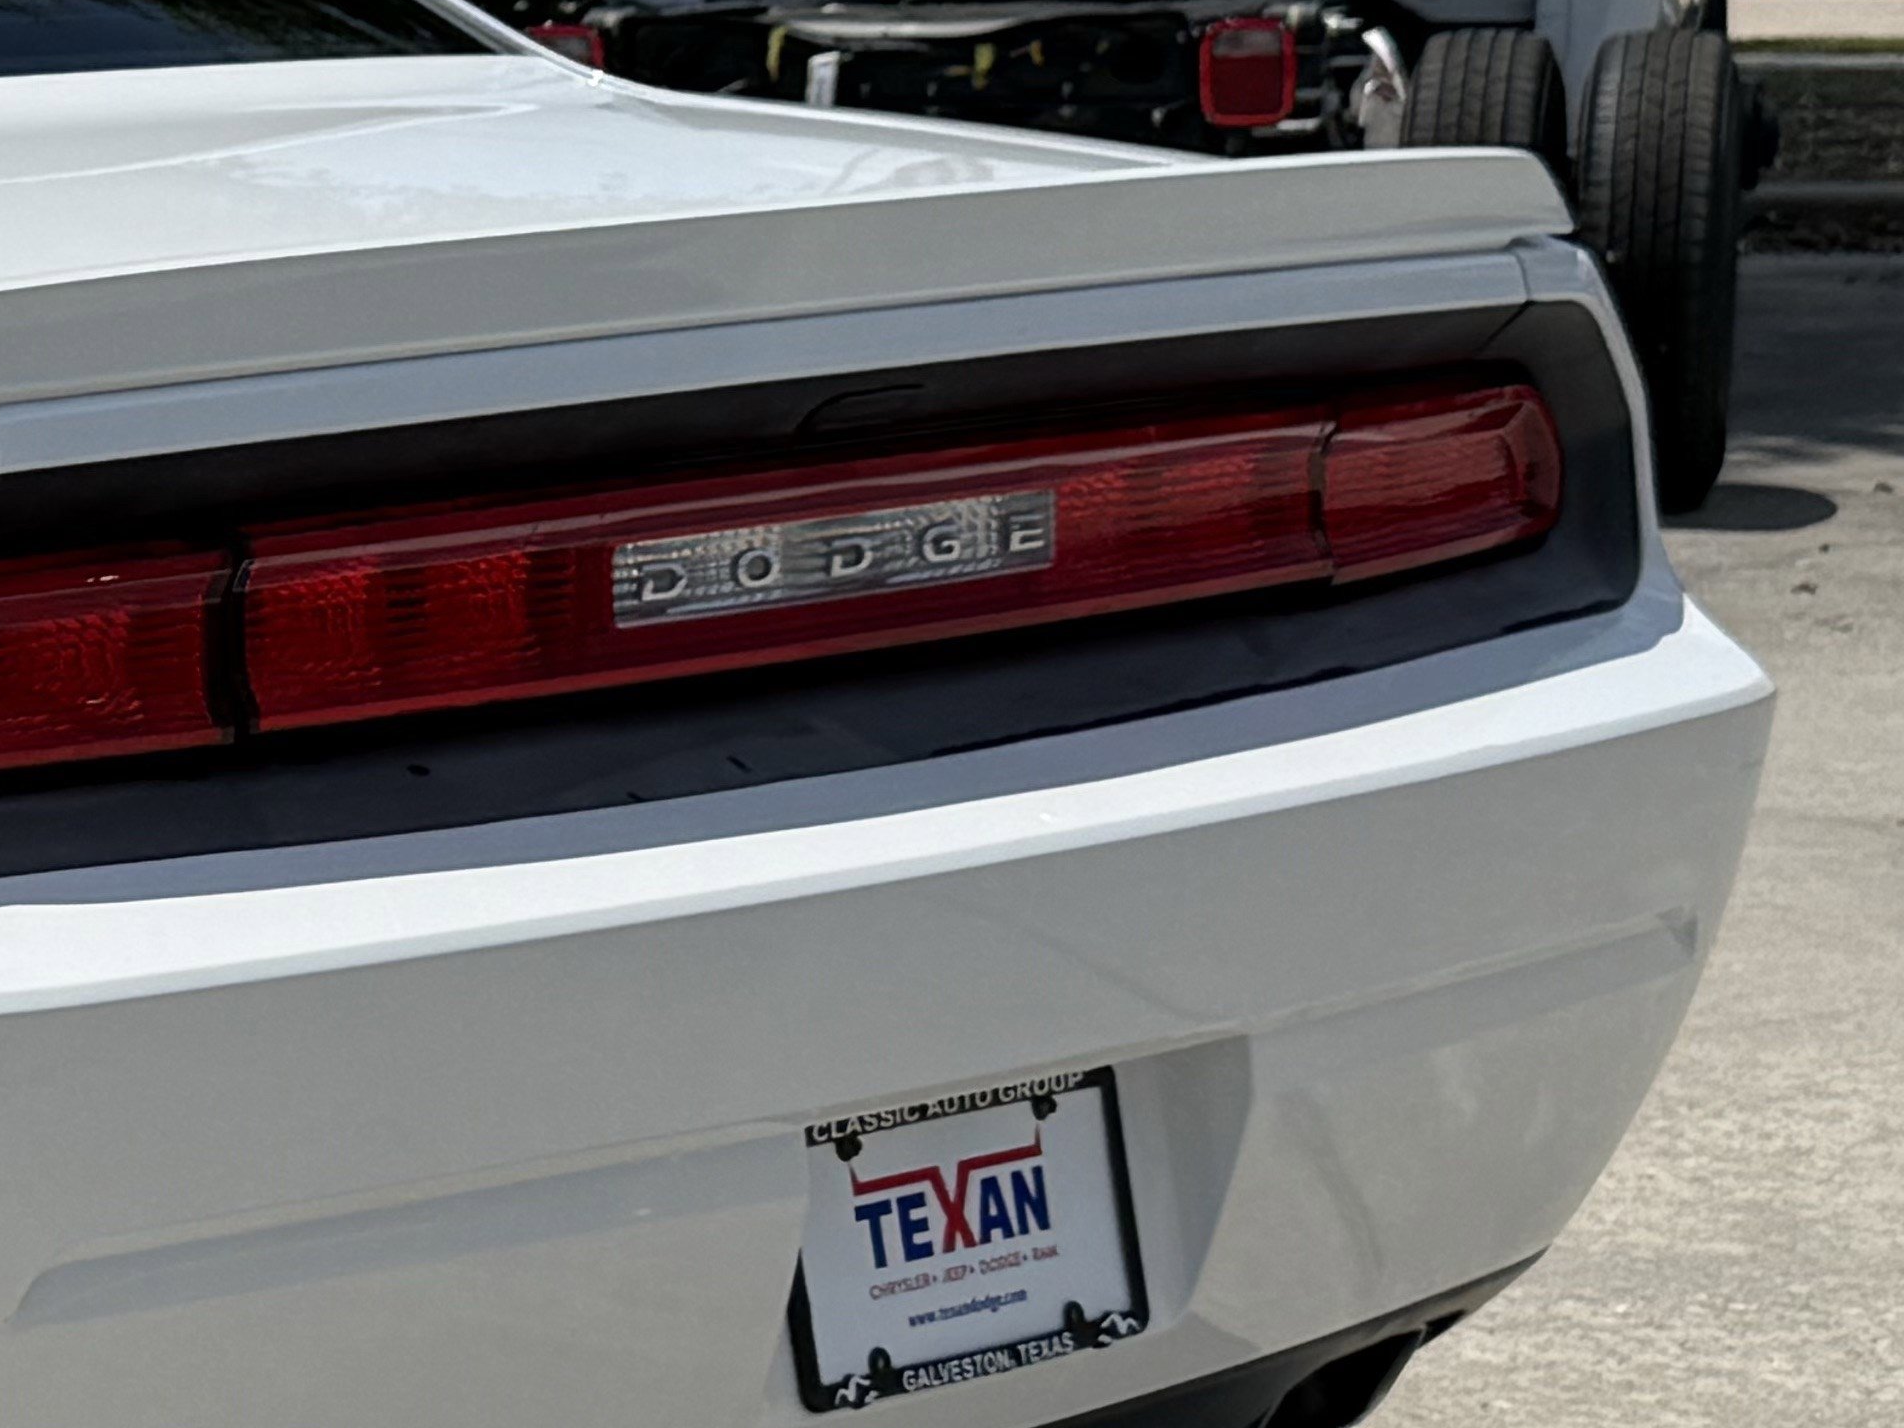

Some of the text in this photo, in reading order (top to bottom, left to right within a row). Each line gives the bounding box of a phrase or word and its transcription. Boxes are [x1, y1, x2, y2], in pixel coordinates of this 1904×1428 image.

[640, 514, 1045, 602] DODGE
[811, 1070, 1086, 1143] CLASSIC AUTO GROUP
[854, 1162, 1052, 1269] TEXAN
[1018, 1331, 1075, 1365] TEXAS
